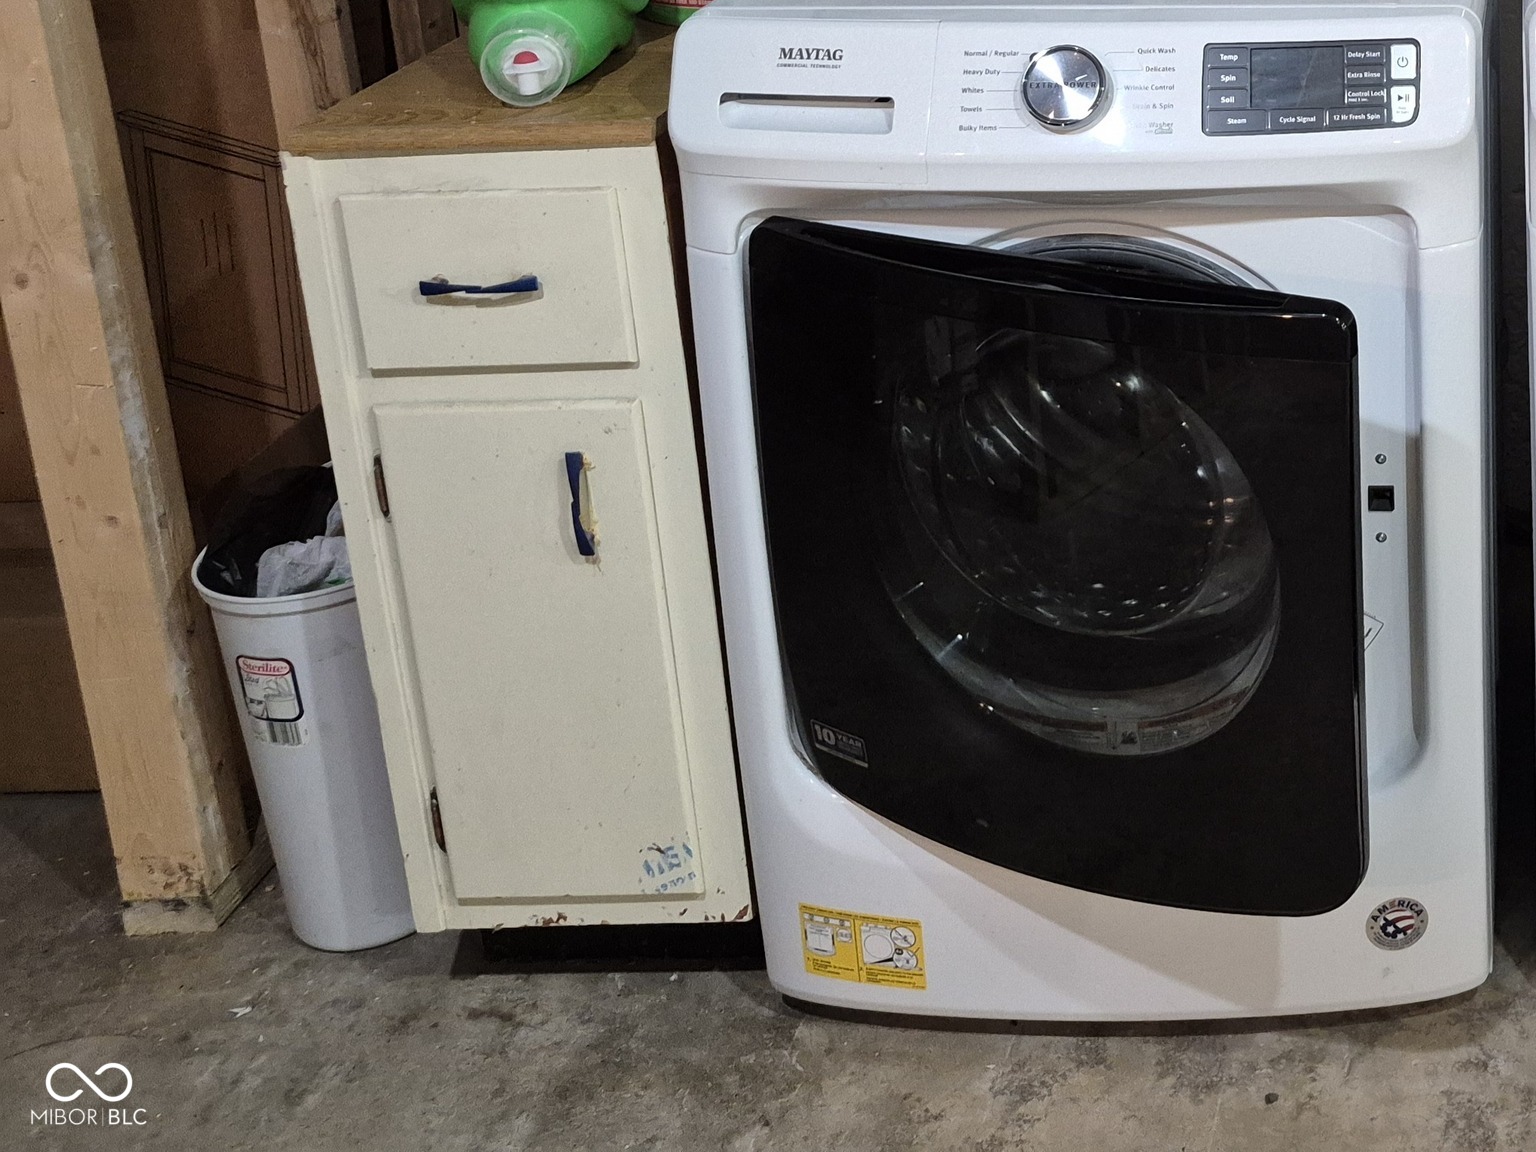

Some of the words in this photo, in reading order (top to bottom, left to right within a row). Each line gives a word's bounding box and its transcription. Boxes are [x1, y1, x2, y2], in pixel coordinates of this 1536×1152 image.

[778, 48, 843, 61] MAYTAG
[994, 50, 1019, 58] Regular
[1220, 54, 1238, 62] Temp
[963, 68, 983, 76] Heavy
[985, 68, 1000, 76] Duty
[1220, 74, 1236, 82] Spin
[1159, 102, 1174, 110] Spin
[1279, 116, 1296, 124] Cycle
[1297, 115, 1316, 124] Signal
[1366, 113, 1380, 121] Spin
[959, 124, 977, 132] Bulky
[242, 659, 284, 673] Sterilite
[814, 723, 836, 746] 10
[1371, 899, 1425, 923] AMERICA
